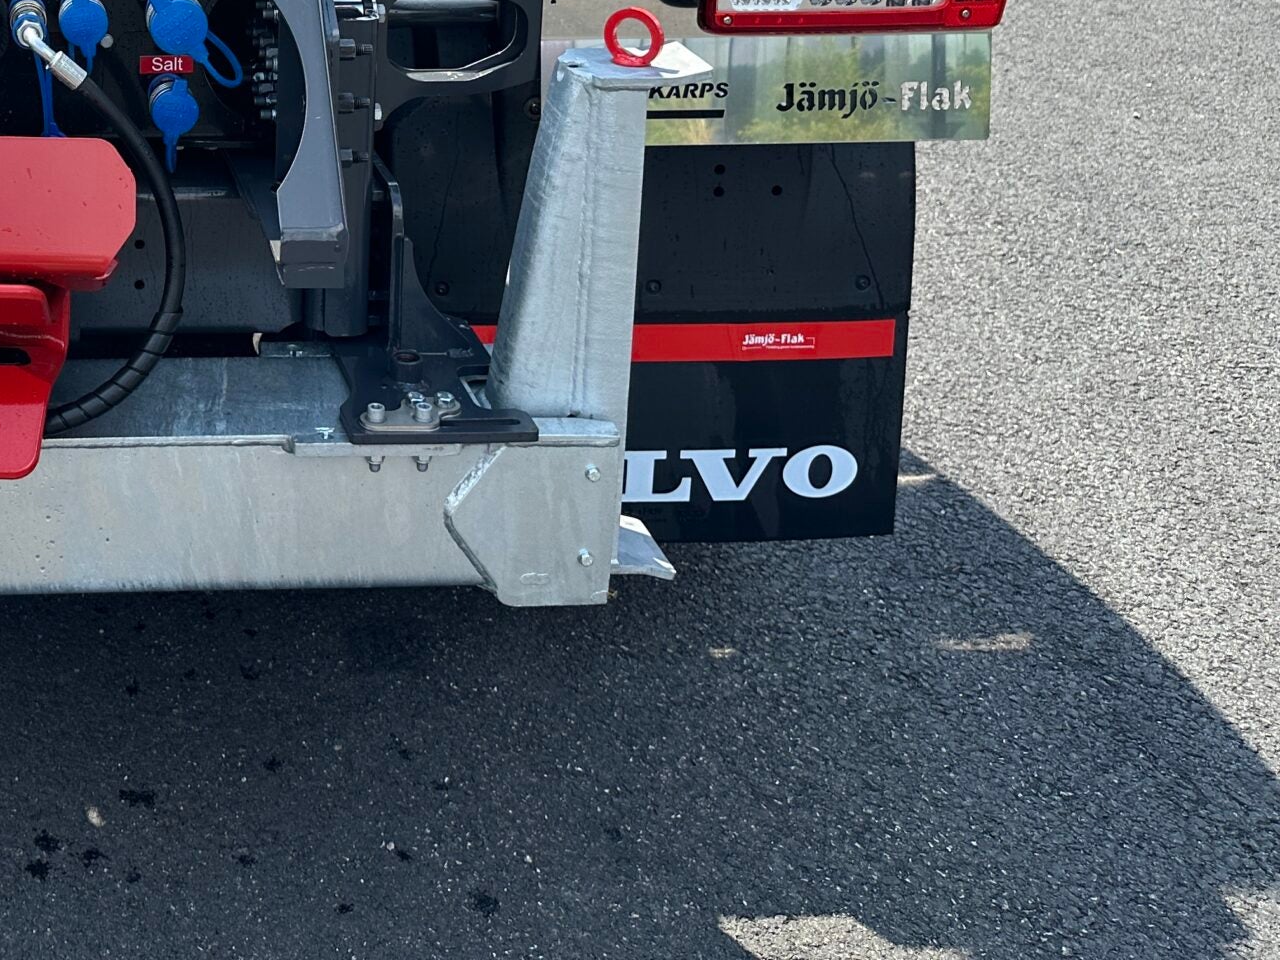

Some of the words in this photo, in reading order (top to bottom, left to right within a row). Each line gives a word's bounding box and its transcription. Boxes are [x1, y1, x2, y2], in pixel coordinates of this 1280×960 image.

[151, 56, 183, 71] Salt
[648, 82, 729, 100] KARPS
[776, 80, 972, 119] Jämjö-Flak
[742, 333, 804, 346] Jämjö-Flak
[621, 445, 858, 502] LVO
